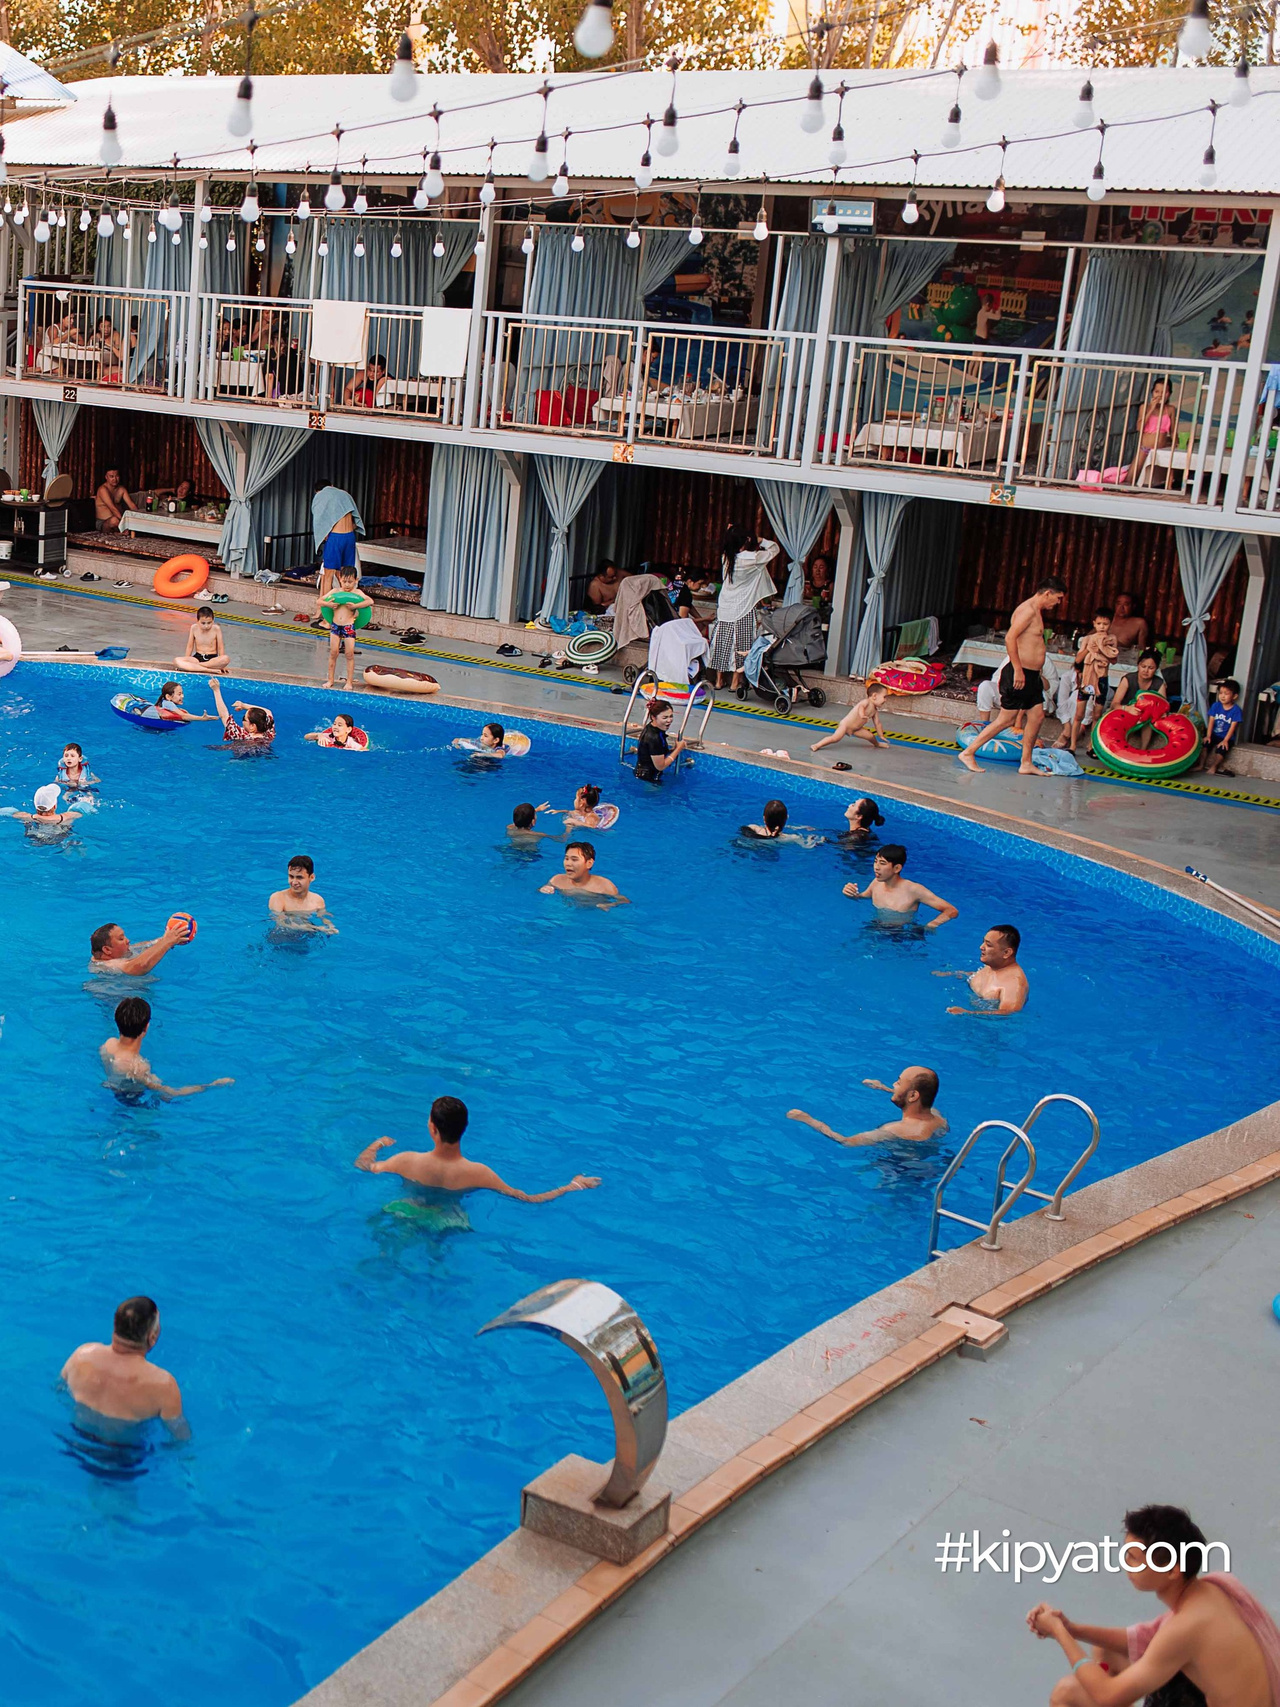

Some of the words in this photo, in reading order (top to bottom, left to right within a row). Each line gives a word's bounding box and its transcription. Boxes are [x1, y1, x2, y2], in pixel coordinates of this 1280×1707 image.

[65, 389, 76, 400] 22
[311, 415, 323, 427] 23
[994, 488, 1012, 502] 25
